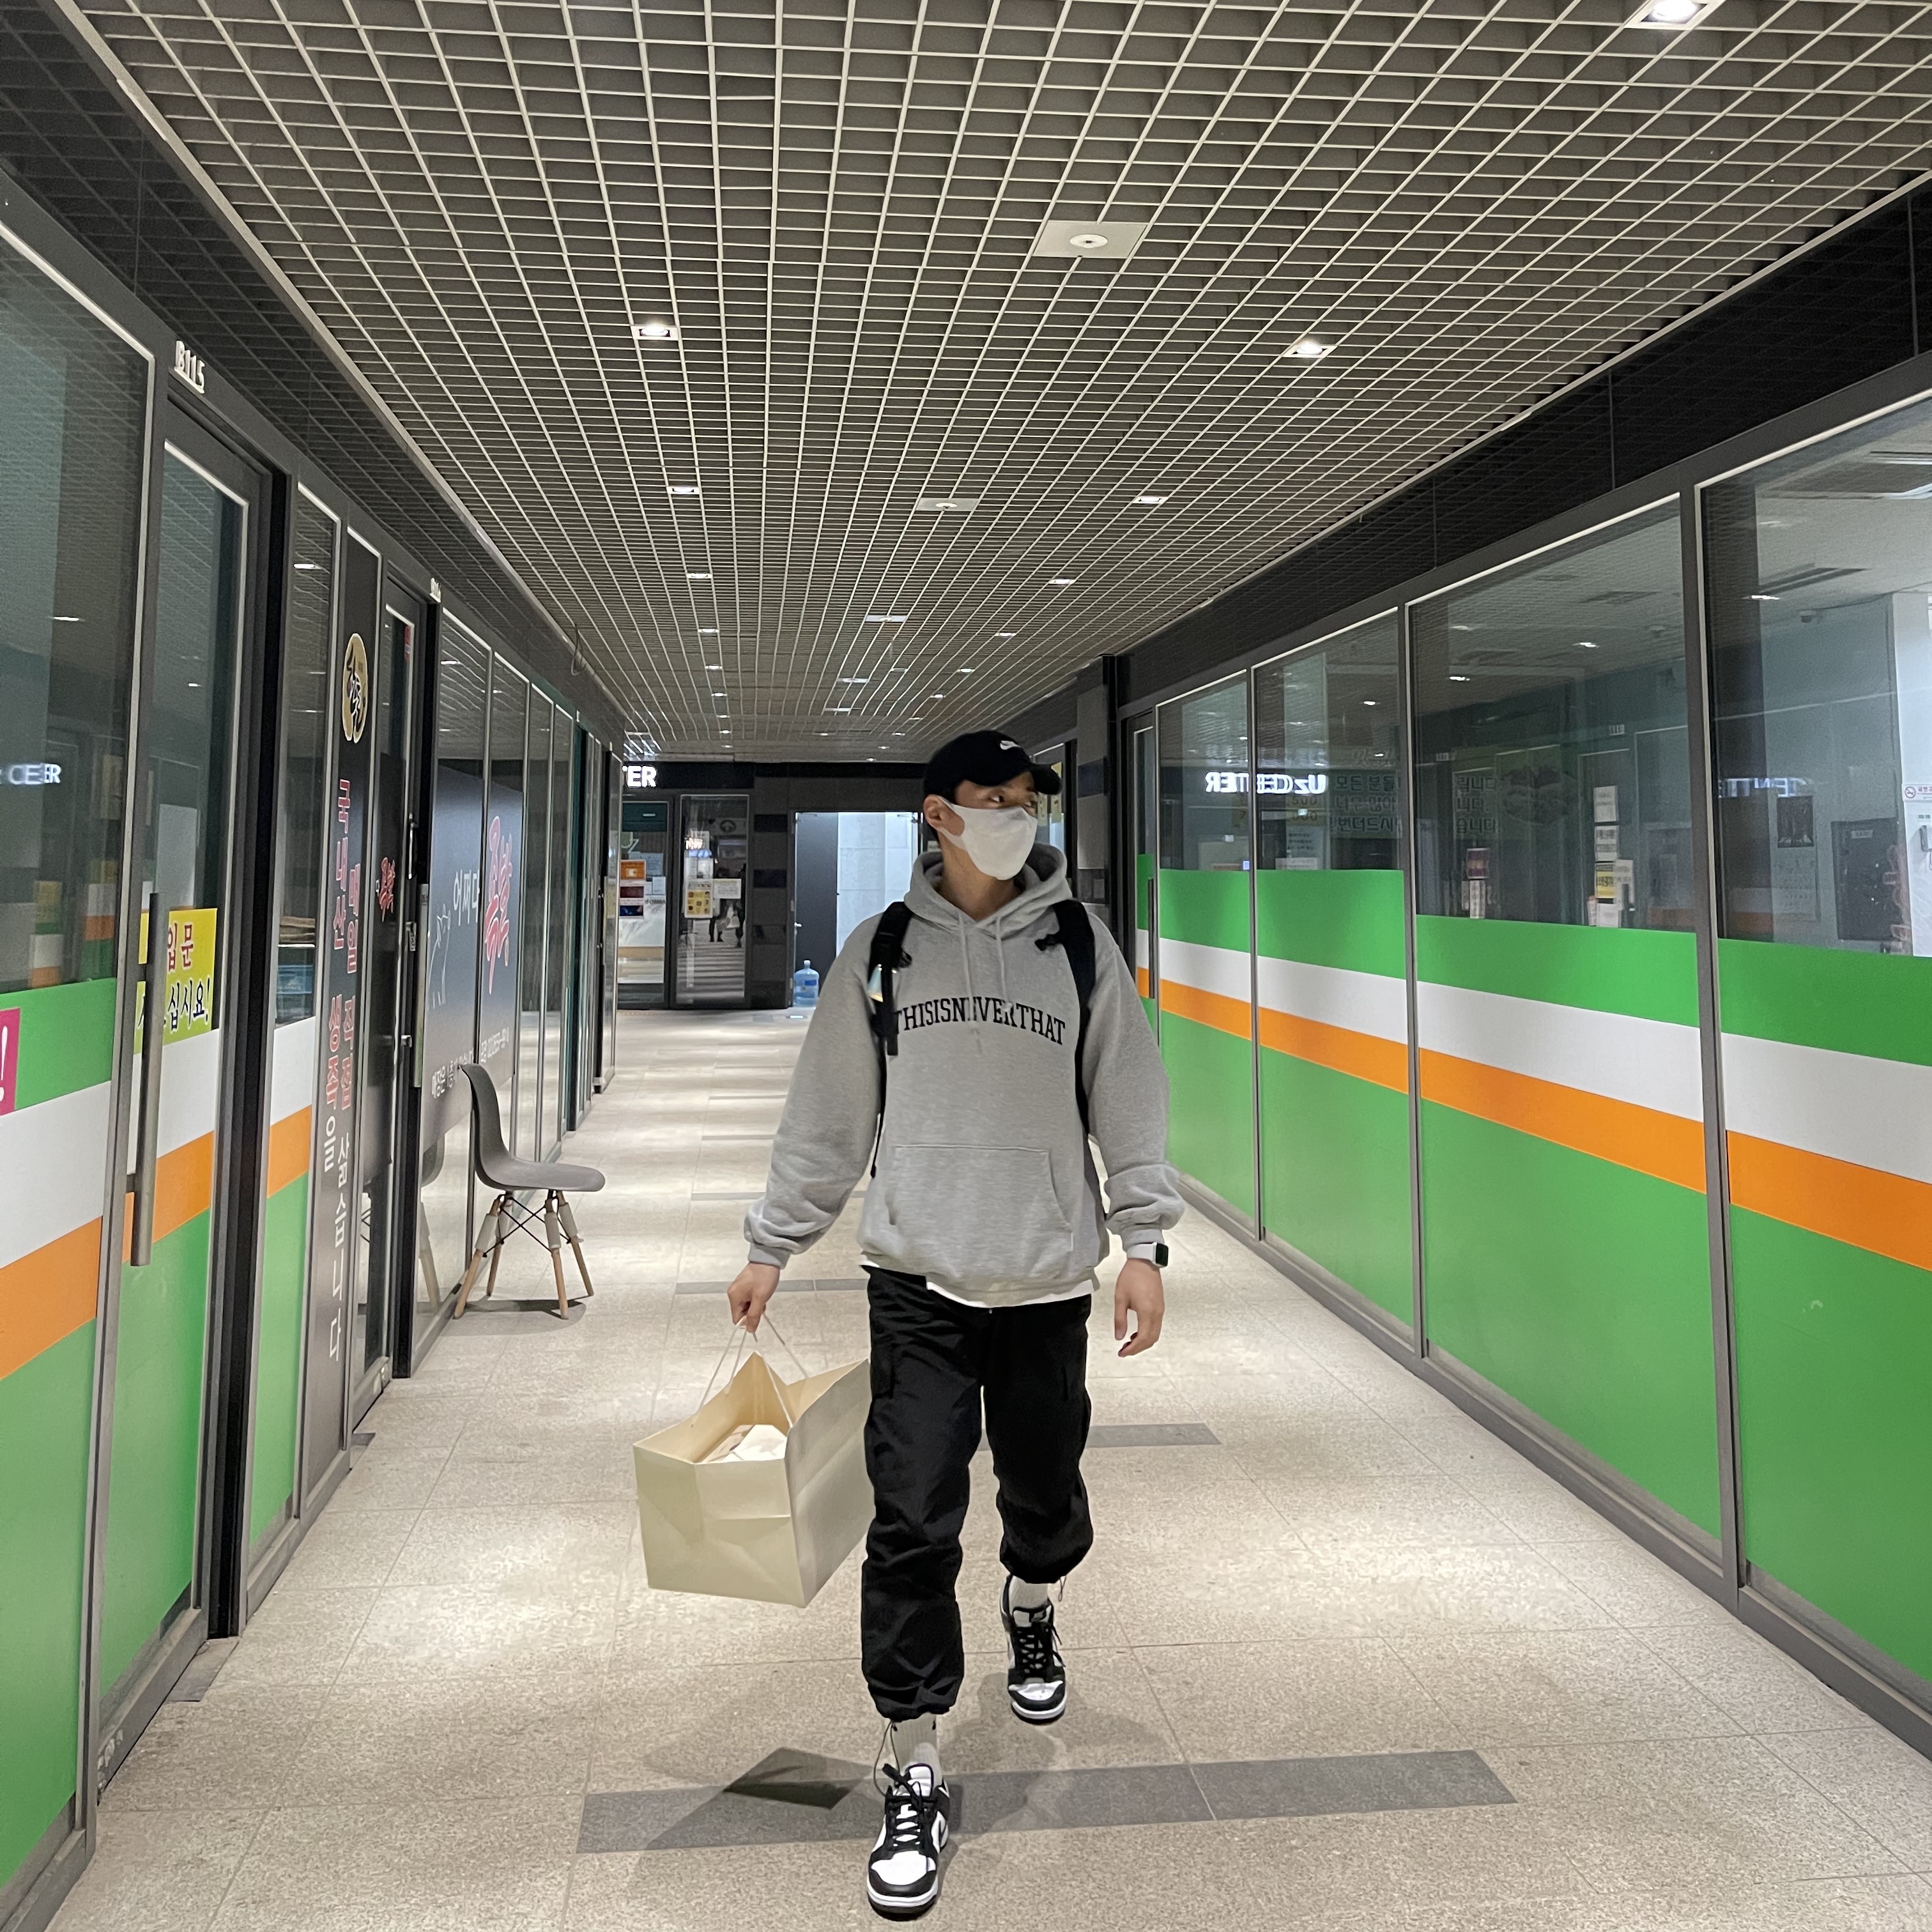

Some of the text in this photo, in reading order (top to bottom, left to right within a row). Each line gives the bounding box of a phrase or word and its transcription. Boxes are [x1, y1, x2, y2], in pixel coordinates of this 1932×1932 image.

[622, 765, 657, 788] ER
[333, 778, 351, 951] 국내산
[347, 863, 361, 974] 매일
[167, 922, 194, 972] 입문
[341, 994, 356, 1110] 직접
